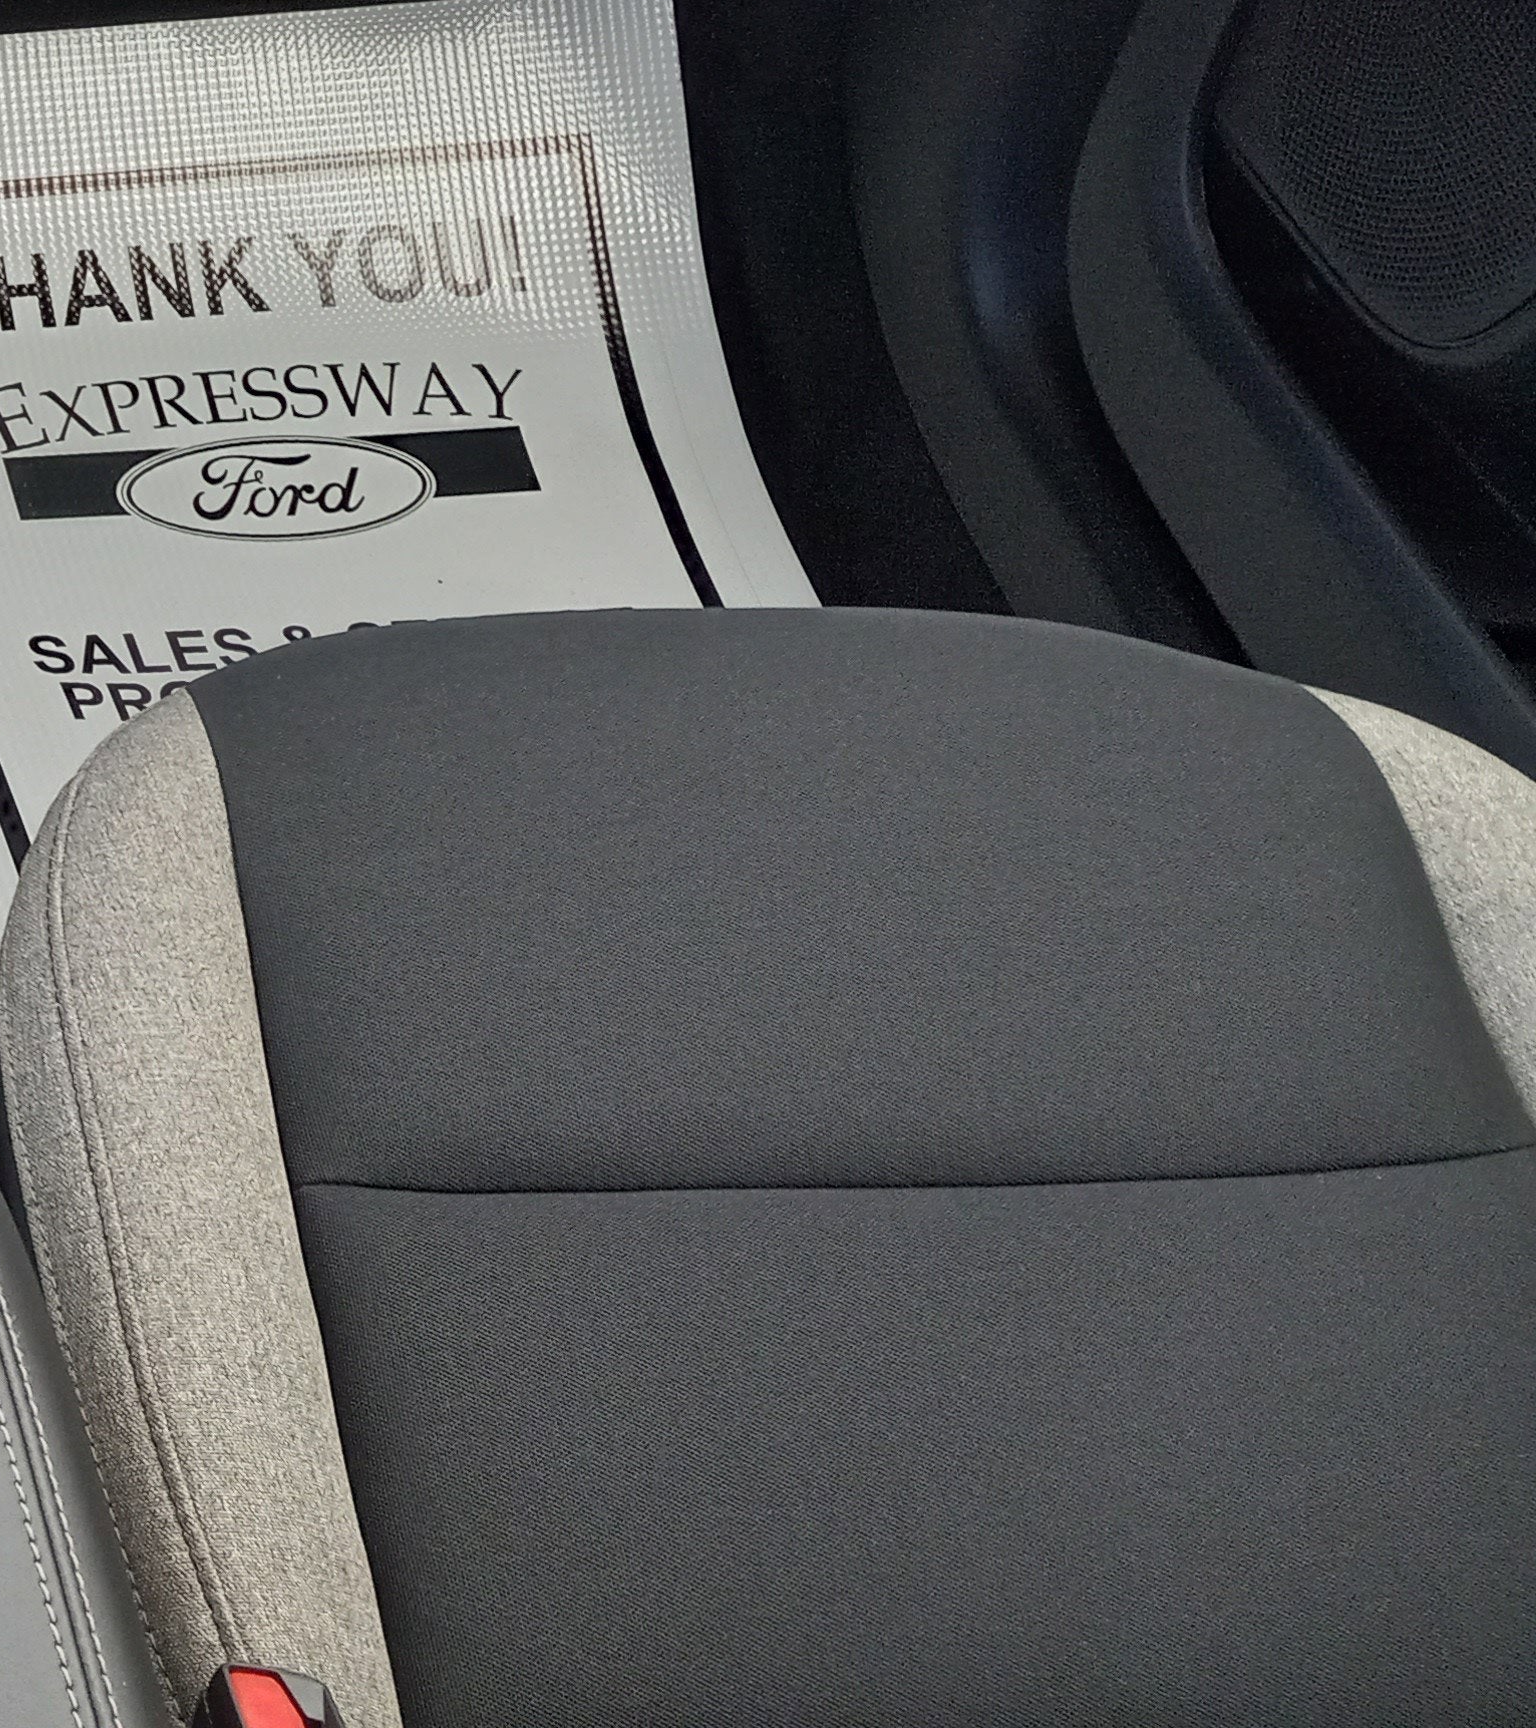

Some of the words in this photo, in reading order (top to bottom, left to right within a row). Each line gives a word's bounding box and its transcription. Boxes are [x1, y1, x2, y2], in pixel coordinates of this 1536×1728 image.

[287, 215, 528, 308] YOU!
[193, 453, 366, 522] Ford
[28, 627, 260, 674] SALES
